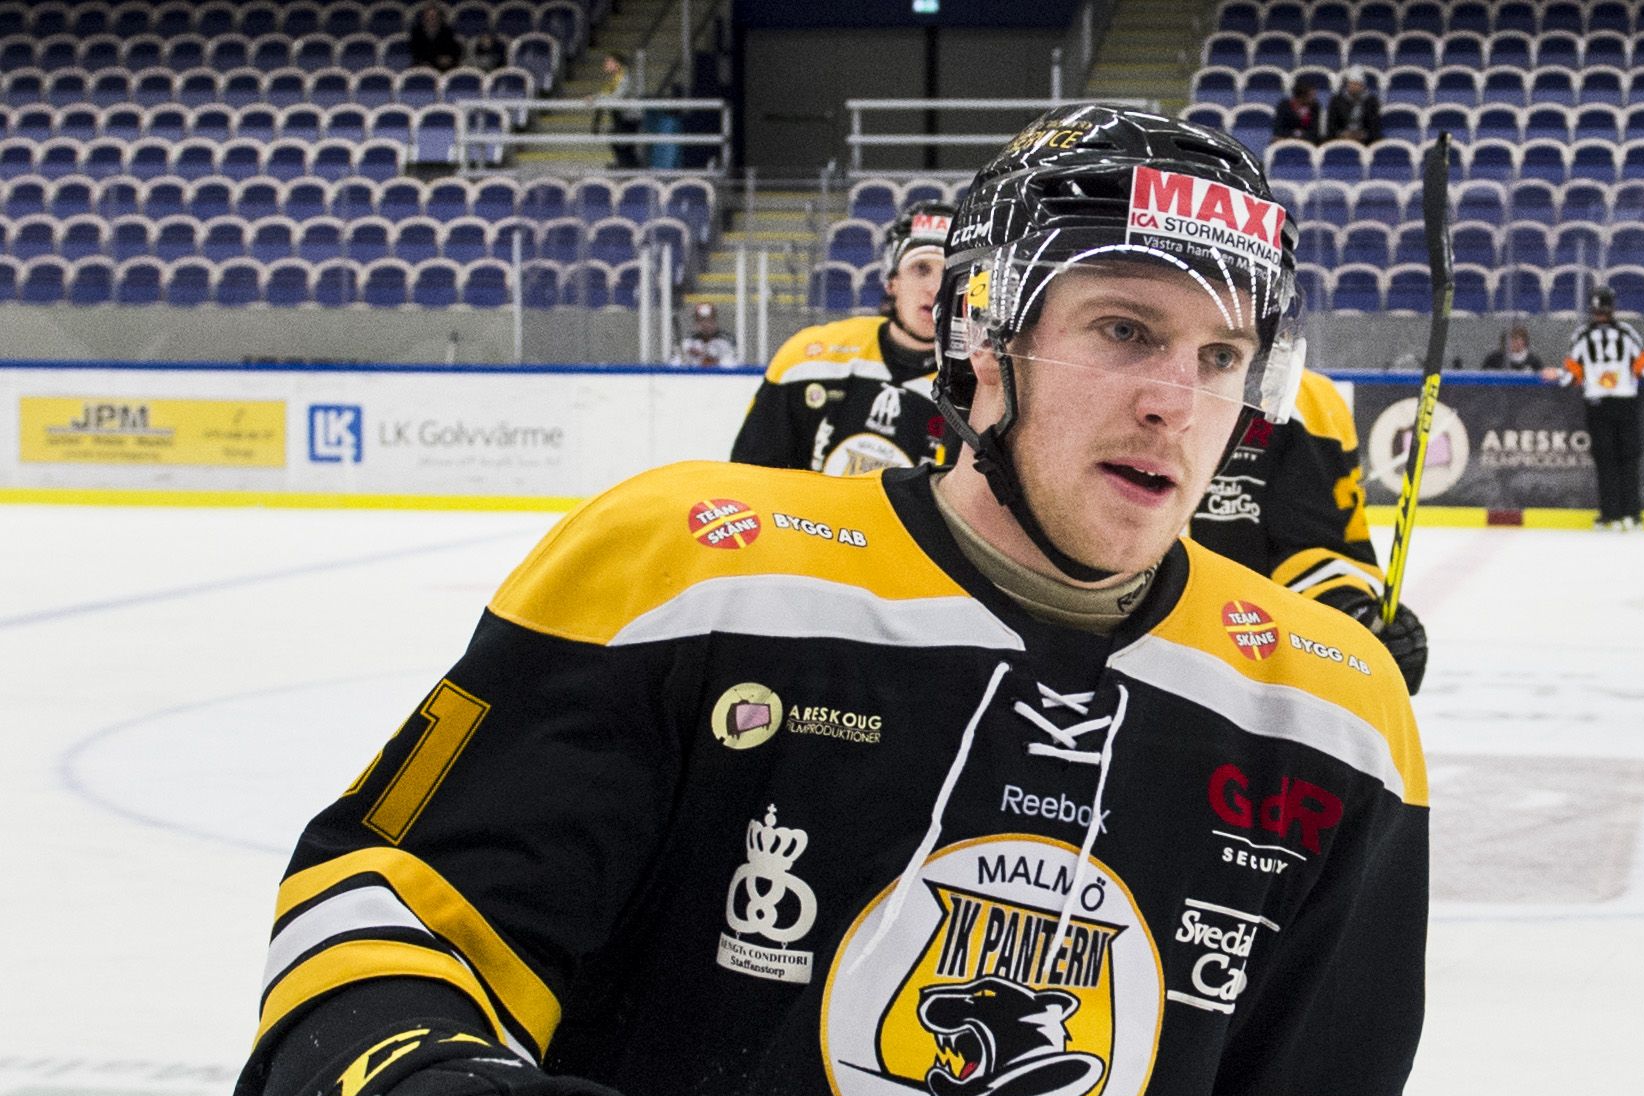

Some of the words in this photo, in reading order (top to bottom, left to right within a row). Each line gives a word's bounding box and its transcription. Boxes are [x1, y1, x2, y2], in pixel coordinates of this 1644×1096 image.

[1133, 166, 1286, 249] MAXI
[950, 221, 991, 246] CCM
[1131, 212, 1159, 228] ICA
[1165, 217, 1281, 266] STORMARKNAD
[1143, 236, 1182, 252] Västra
[1187, 244, 1234, 265] hamen
[71, 404, 149, 430] JPM
[379, 420, 411, 447] LK
[417, 419, 564, 448] Golvvärme
[696, 504, 740, 525] TEAM
[707, 518, 758, 545] SKÅNE
[773, 512, 834, 540] BYGG
[837, 528, 868, 548] AB
[1228, 611, 1261, 625] TEAM
[1236, 631, 1276, 647] SKÅNE
[1289, 632, 1344, 662] BYGG
[1348, 655, 1371, 675] AB
[1206, 762, 1344, 856] GdR
[977, 854, 1107, 912] MALMÖ
[935, 895, 983, 978] IK
[976, 903, 1111, 988] PANTERN
[730, 955, 786, 979] Staffanstorp
